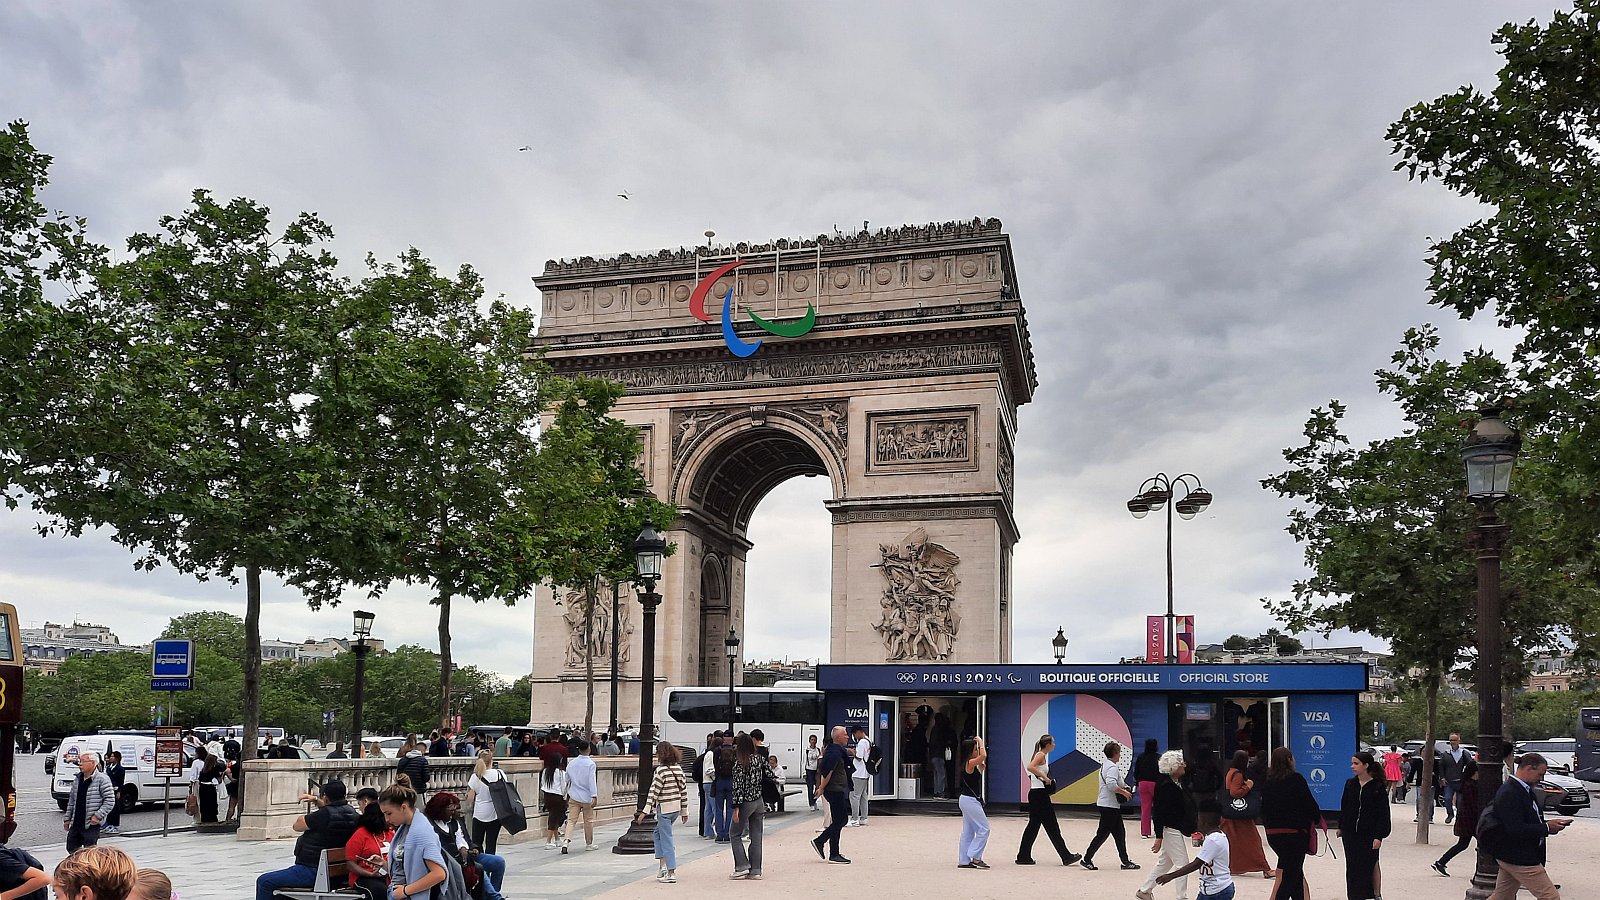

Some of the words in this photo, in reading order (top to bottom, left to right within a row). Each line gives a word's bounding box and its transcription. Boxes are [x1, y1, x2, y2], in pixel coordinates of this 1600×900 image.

[1152, 621, 1160, 647] 2024
[966, 673, 1002, 683] 2024
[1040, 673, 1096, 683] BOUTIQUE
[1098, 673, 1160, 683] OFFICIELLE
[1179, 673, 1230, 683] OFFICIAL
[1232, 673, 1269, 683] STORE
[845, 708, 869, 718] VISA
[1302, 711, 1331, 721] VISA
